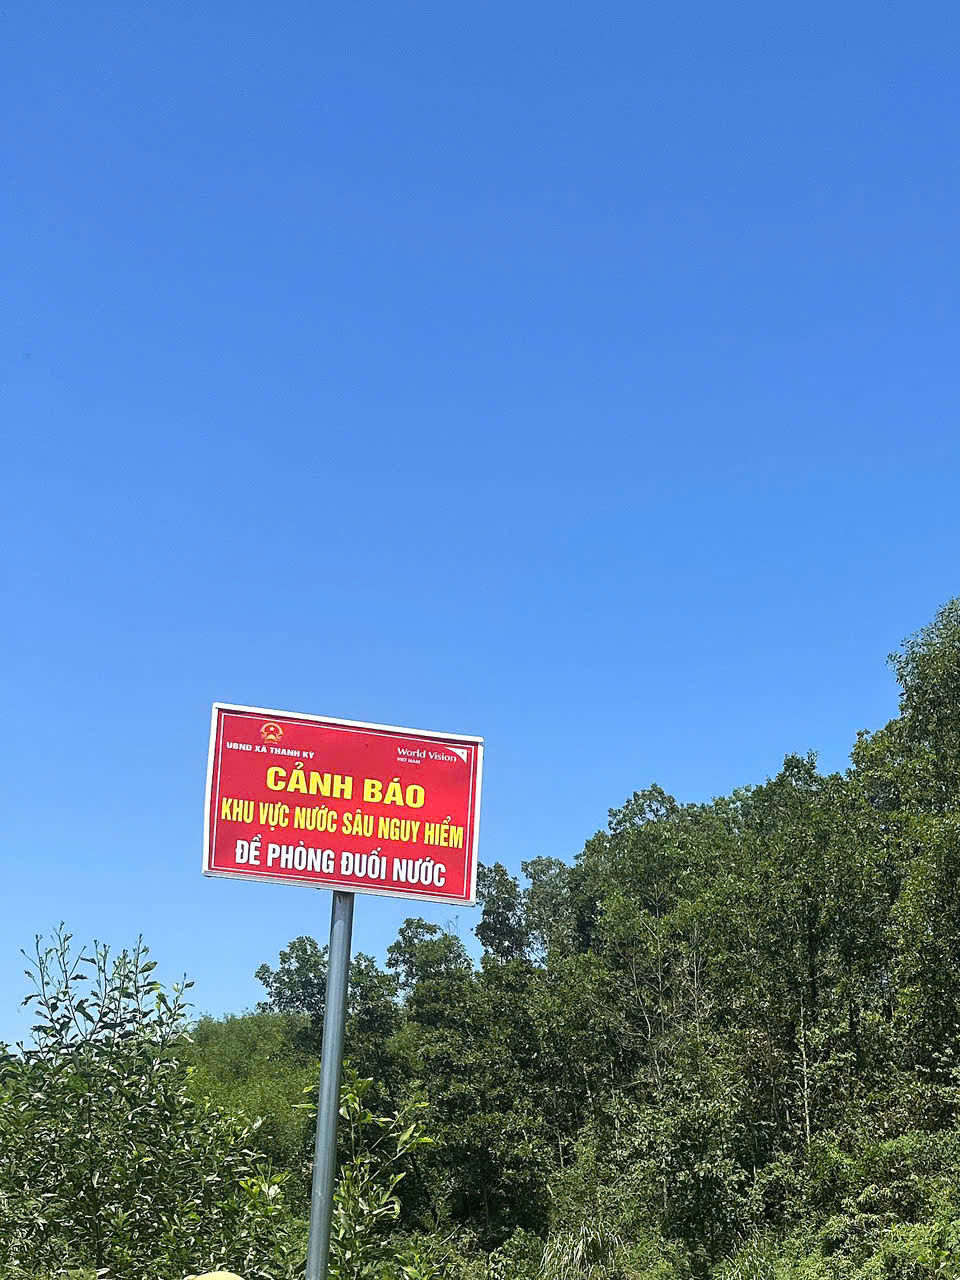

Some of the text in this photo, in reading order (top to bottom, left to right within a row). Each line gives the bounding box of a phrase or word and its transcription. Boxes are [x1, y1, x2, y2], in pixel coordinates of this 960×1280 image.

[226, 741, 252, 751] UBND
[269, 746, 301, 757] THANH
[397, 747, 457, 763] World Vision
[266, 761, 426, 809] CẢNH BÁO
[221, 797, 464, 849] KHU VỰC NƯỚC SÂU NGUY HIỂM
[235, 833, 447, 887] ĐỀ PHÒNG ĐUỐI NƯỚC
